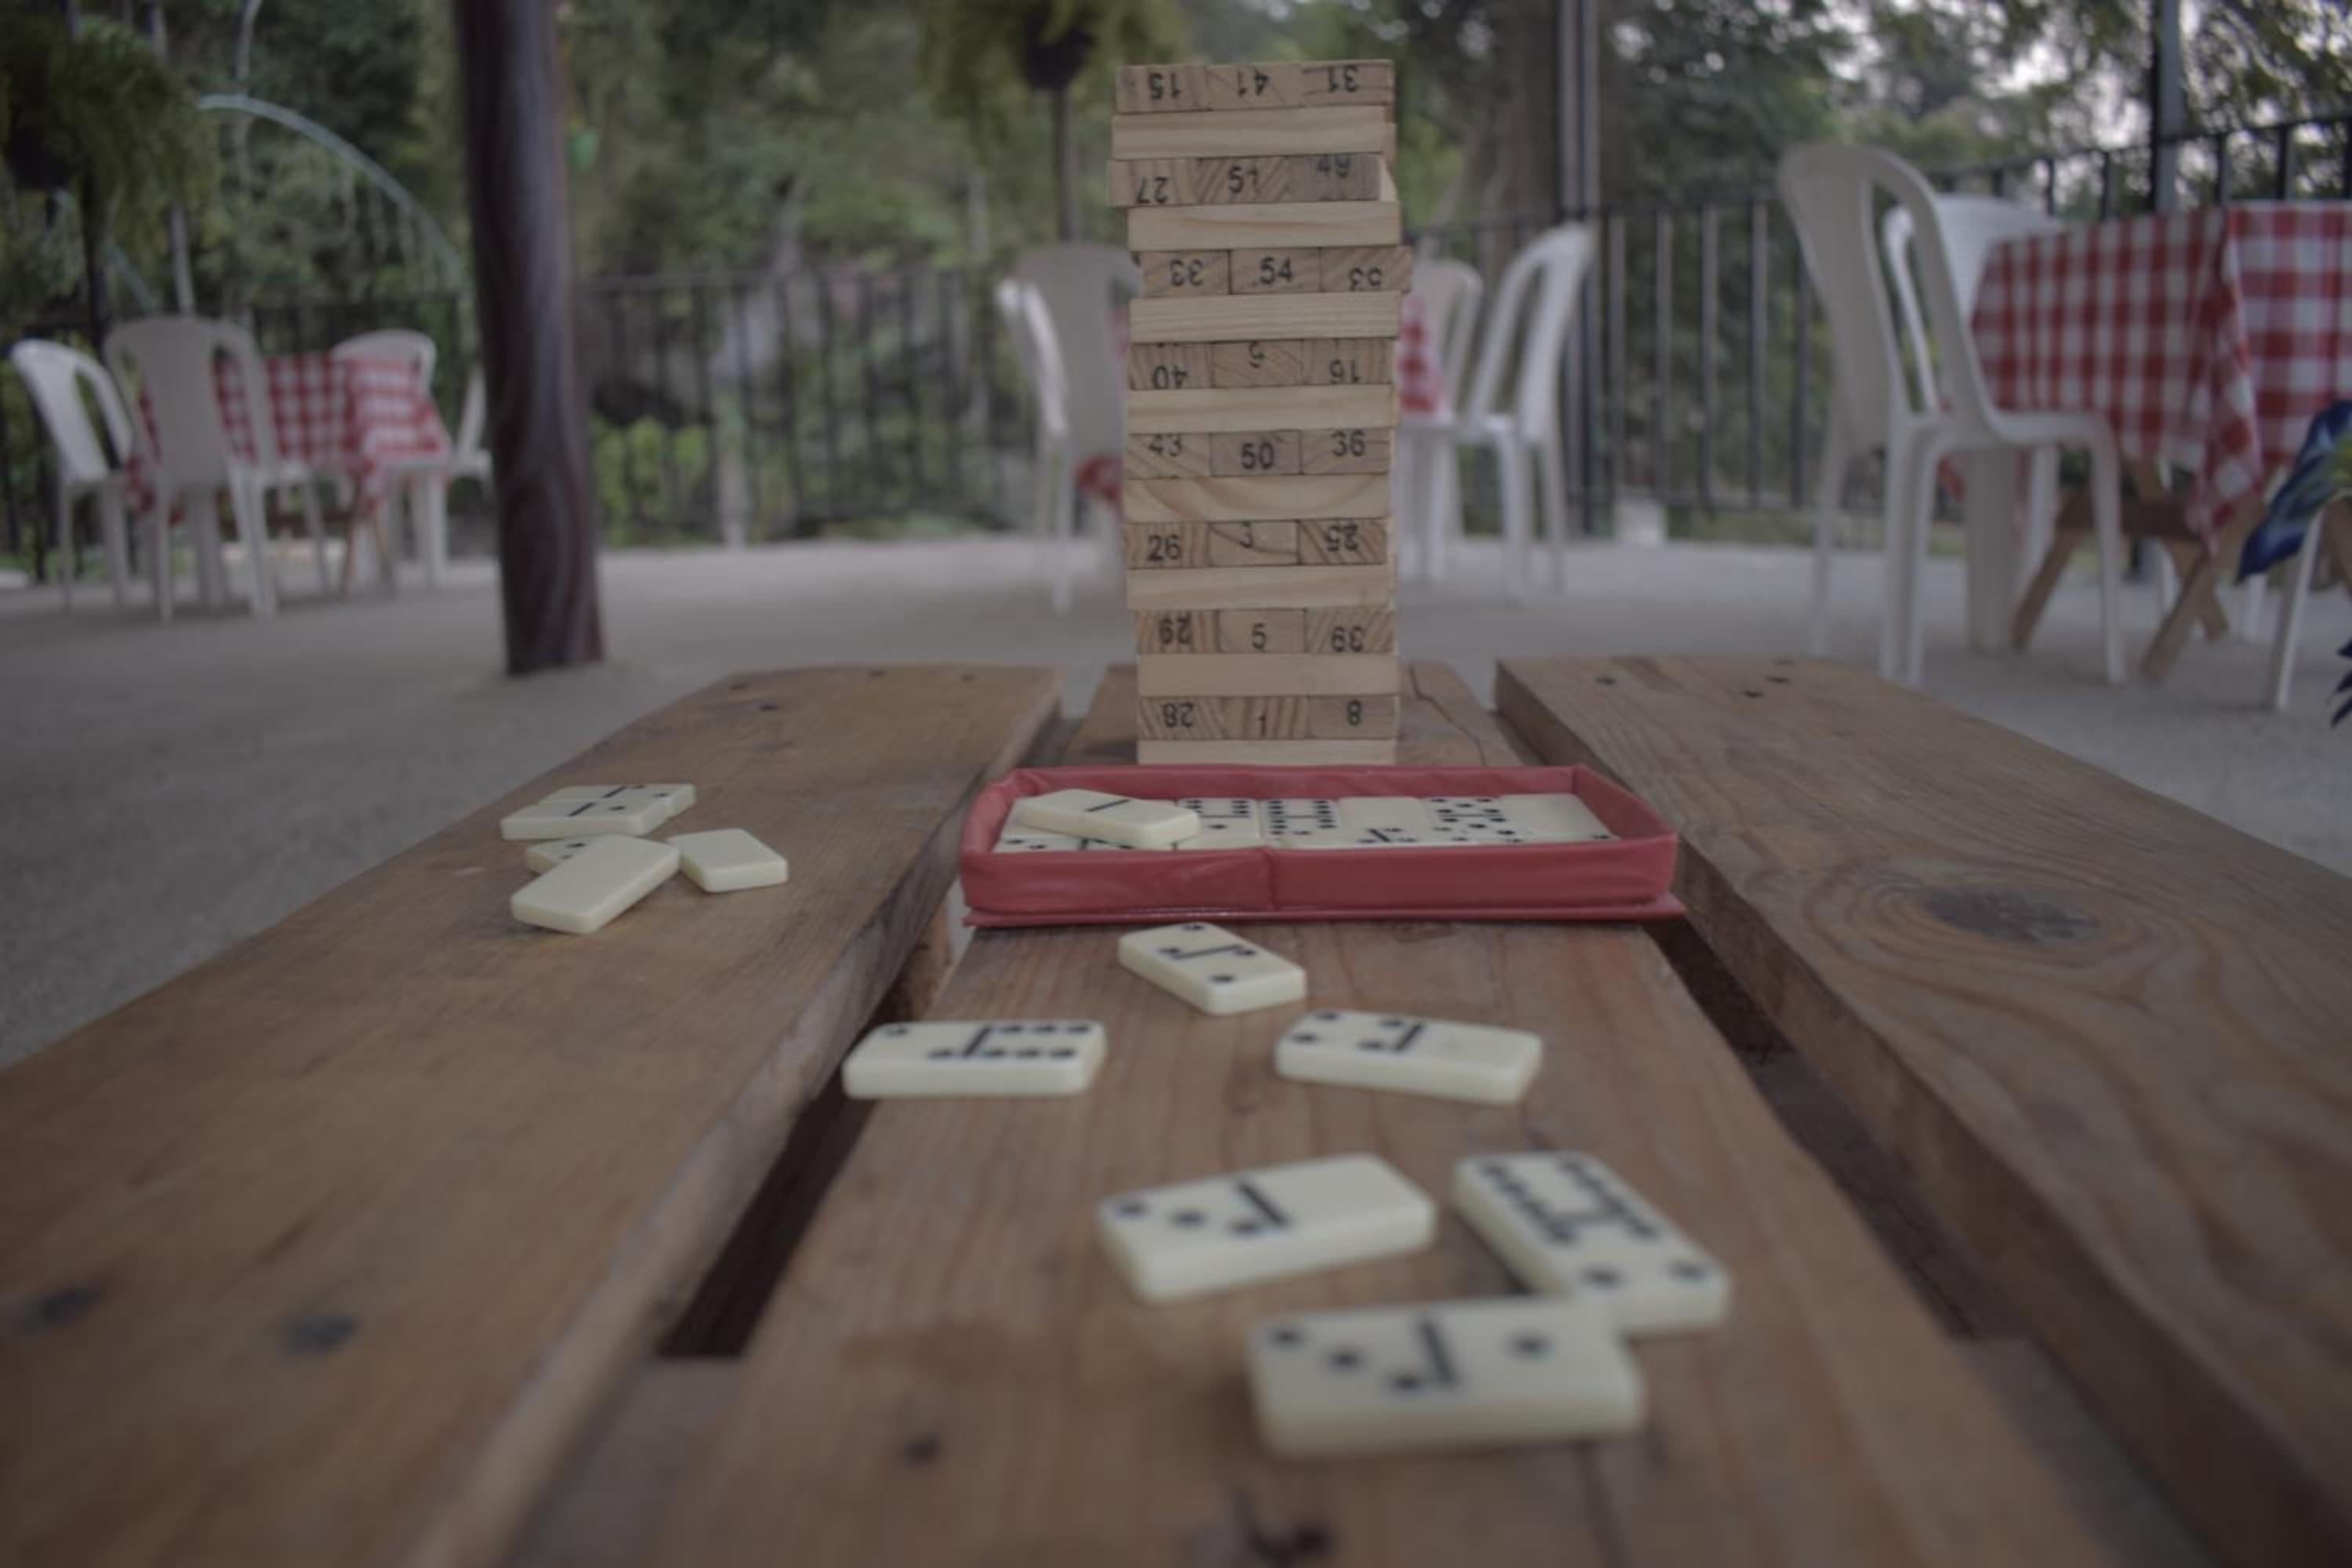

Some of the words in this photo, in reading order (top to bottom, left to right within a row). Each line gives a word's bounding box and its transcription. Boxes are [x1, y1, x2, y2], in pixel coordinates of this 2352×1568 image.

[1238, 70, 1269, 96] 41
[1329, 65, 1358, 93] 31
[1136, 176, 1167, 204] 27
[1229, 165, 1259, 194] 51
[1169, 259, 1203, 286] 33
[1259, 256, 1294, 285] 54
[1152, 365, 1188, 389] 40
[1149, 434, 1181, 457] 43
[1241, 441, 1275, 470] 50
[1331, 430, 1365, 457] 36
[1148, 535, 1181, 562] 26
[1325, 524, 1358, 552] 25
[1159, 616, 1192, 645] 29
[1251, 623, 1267, 652] 5
[1331, 626, 1364, 652] 39
[1163, 702, 1194, 728] 28
[1258, 714, 1267, 737] 1
[1346, 700, 1363, 726] 8
